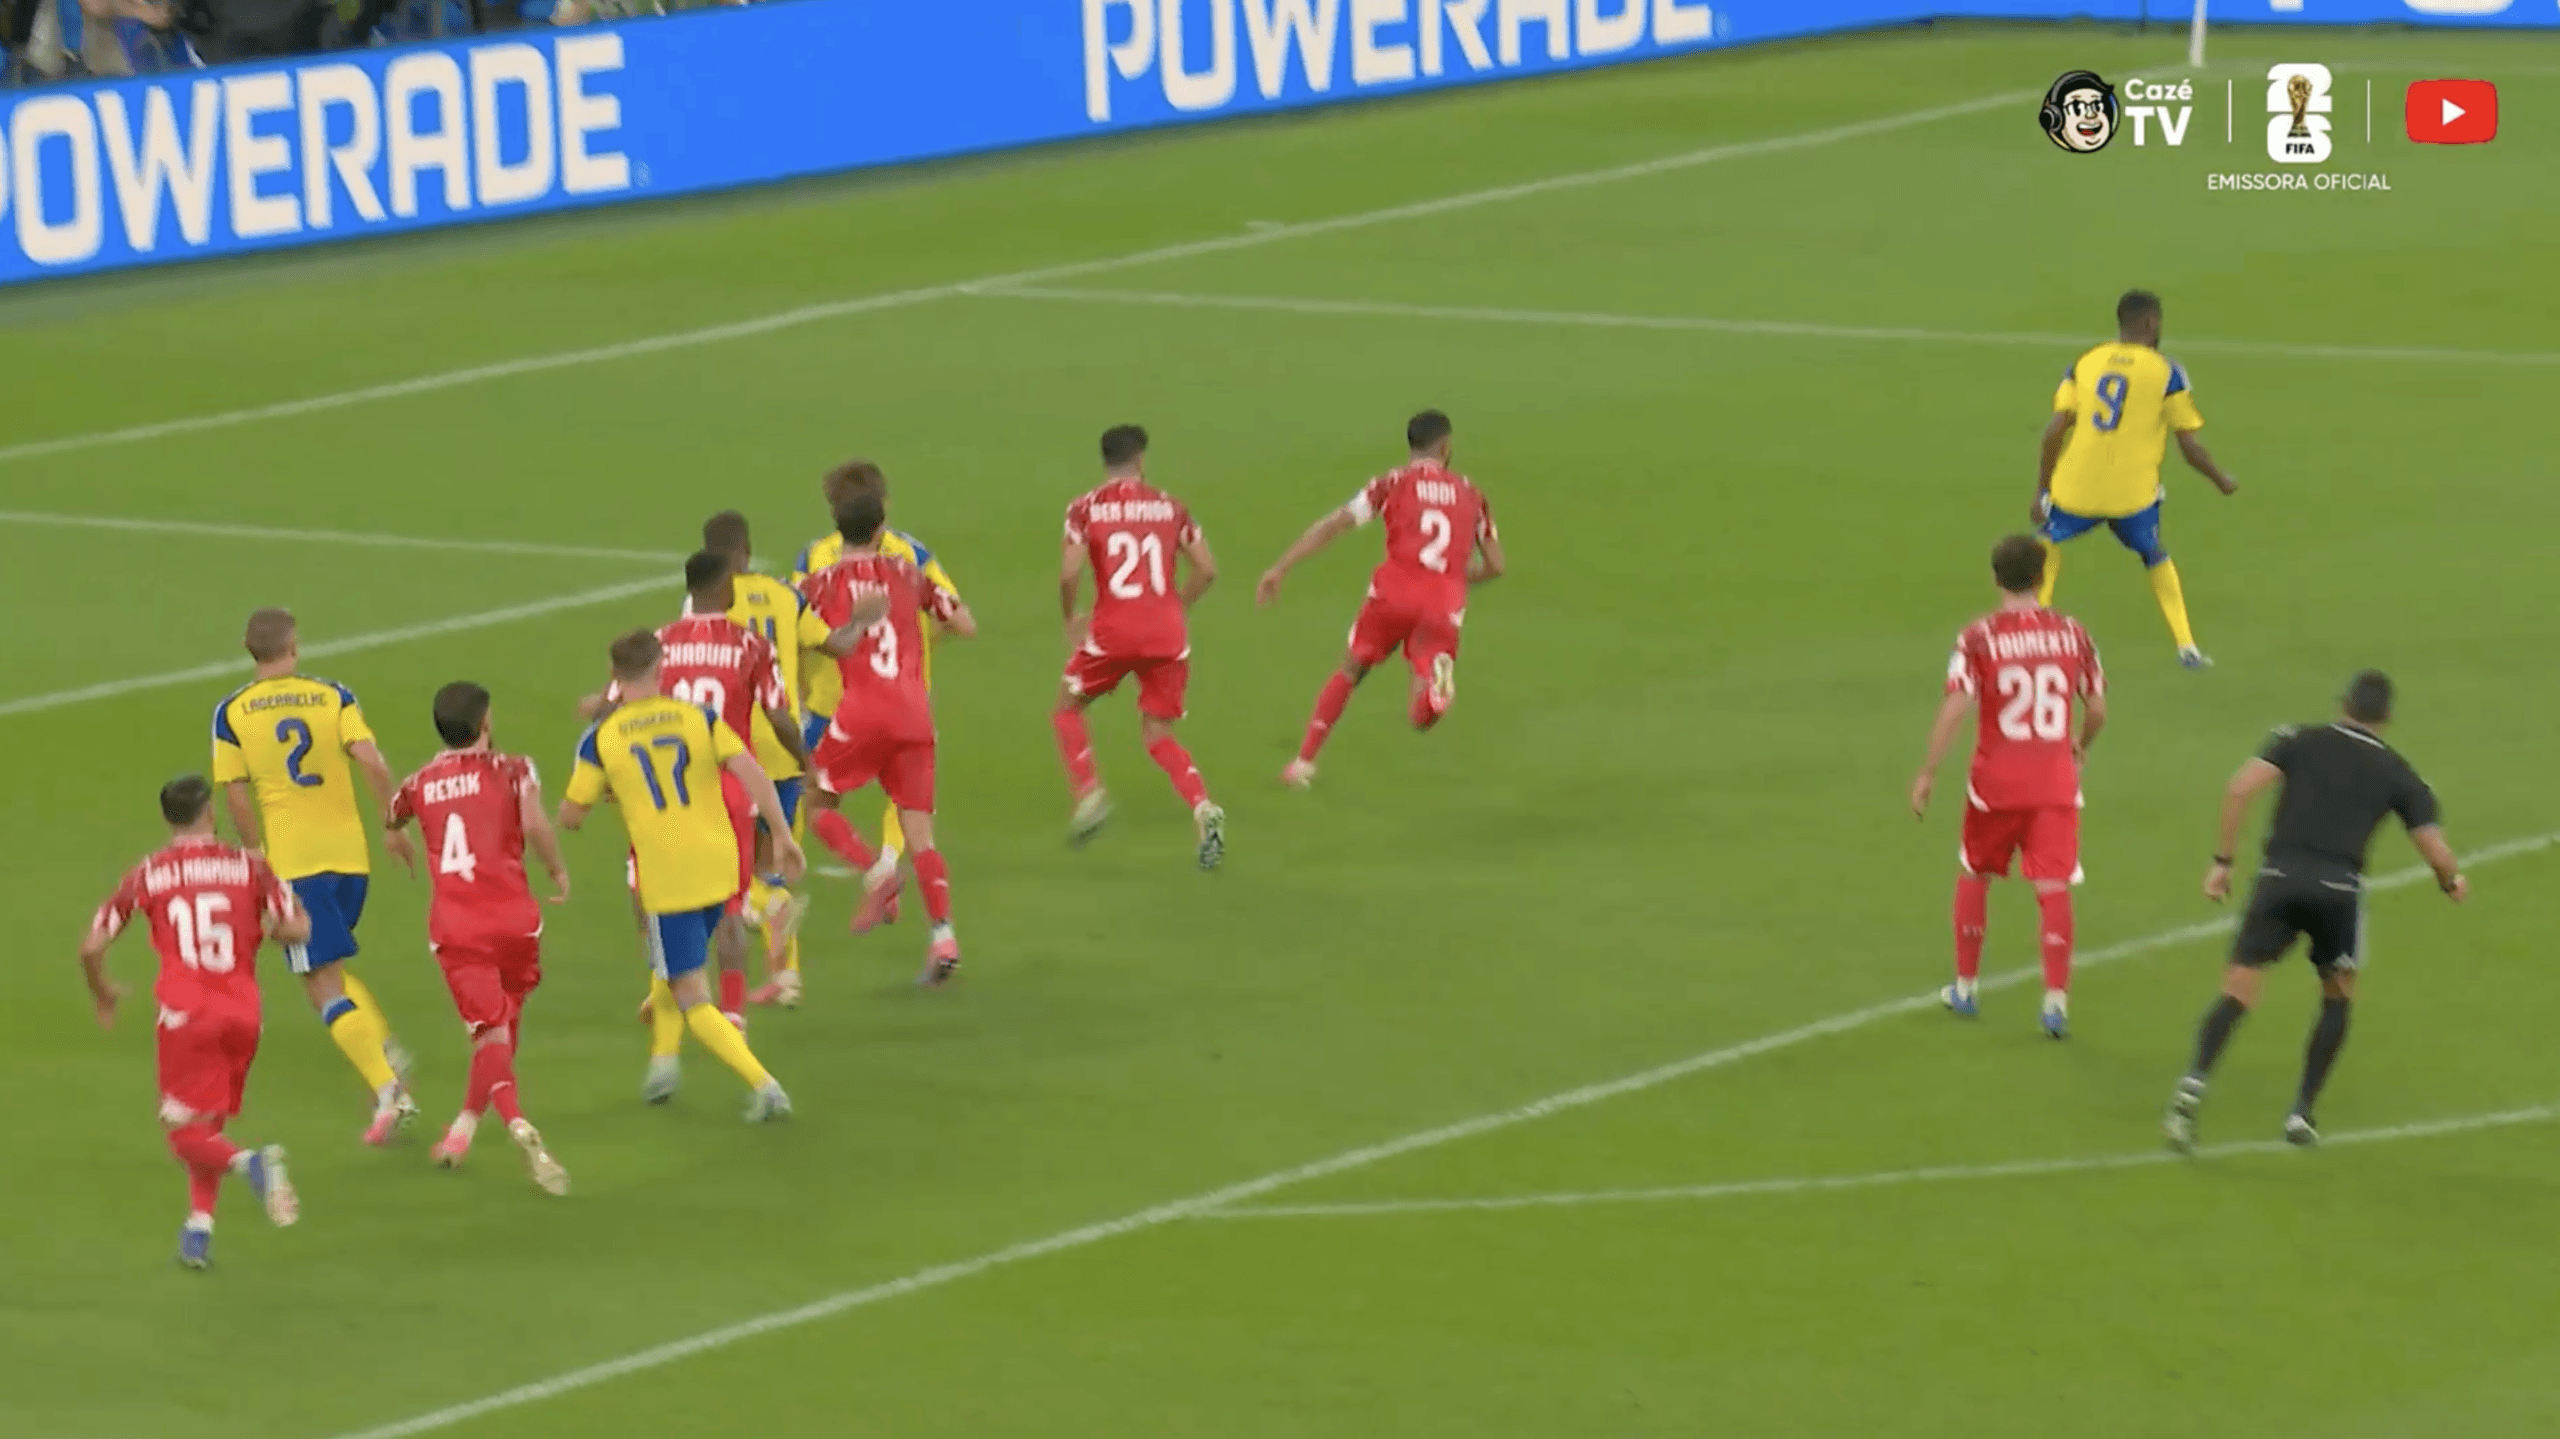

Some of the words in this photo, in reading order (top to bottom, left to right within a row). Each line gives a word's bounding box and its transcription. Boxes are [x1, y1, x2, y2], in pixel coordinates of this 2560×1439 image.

[0, 32, 630, 266] OWERADE
[2093, 373, 2129, 431] 9
[1107, 531, 1166, 599] 21
[1419, 510, 1451, 574] 2
[868, 617, 899, 680] 3
[1998, 664, 2069, 742] 26
[276, 717, 324, 787] 2
[630, 734, 691, 811] 17
[423, 770, 481, 806] REKIK
[439, 812, 477, 884] 4
[167, 892, 236, 973] 15
